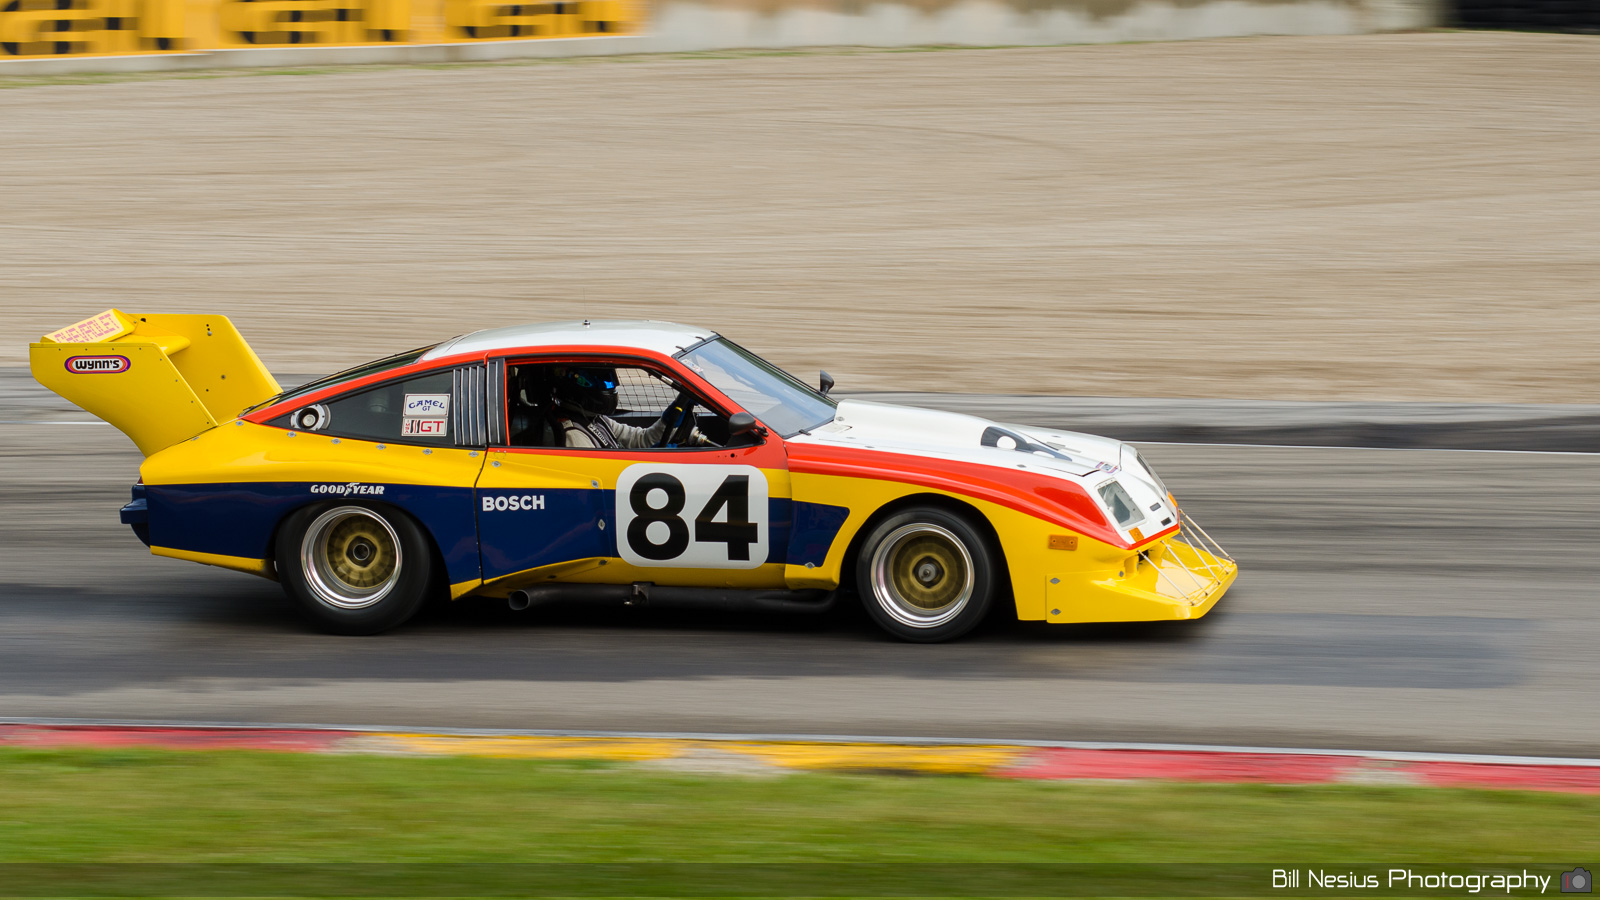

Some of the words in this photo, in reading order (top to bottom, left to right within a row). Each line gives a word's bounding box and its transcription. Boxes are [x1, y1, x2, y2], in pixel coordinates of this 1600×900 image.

[408, 399, 445, 409] CAMEL
[420, 420, 445, 433] GT
[482, 495, 545, 512] BOSCH
[626, 472, 759, 561] 84
